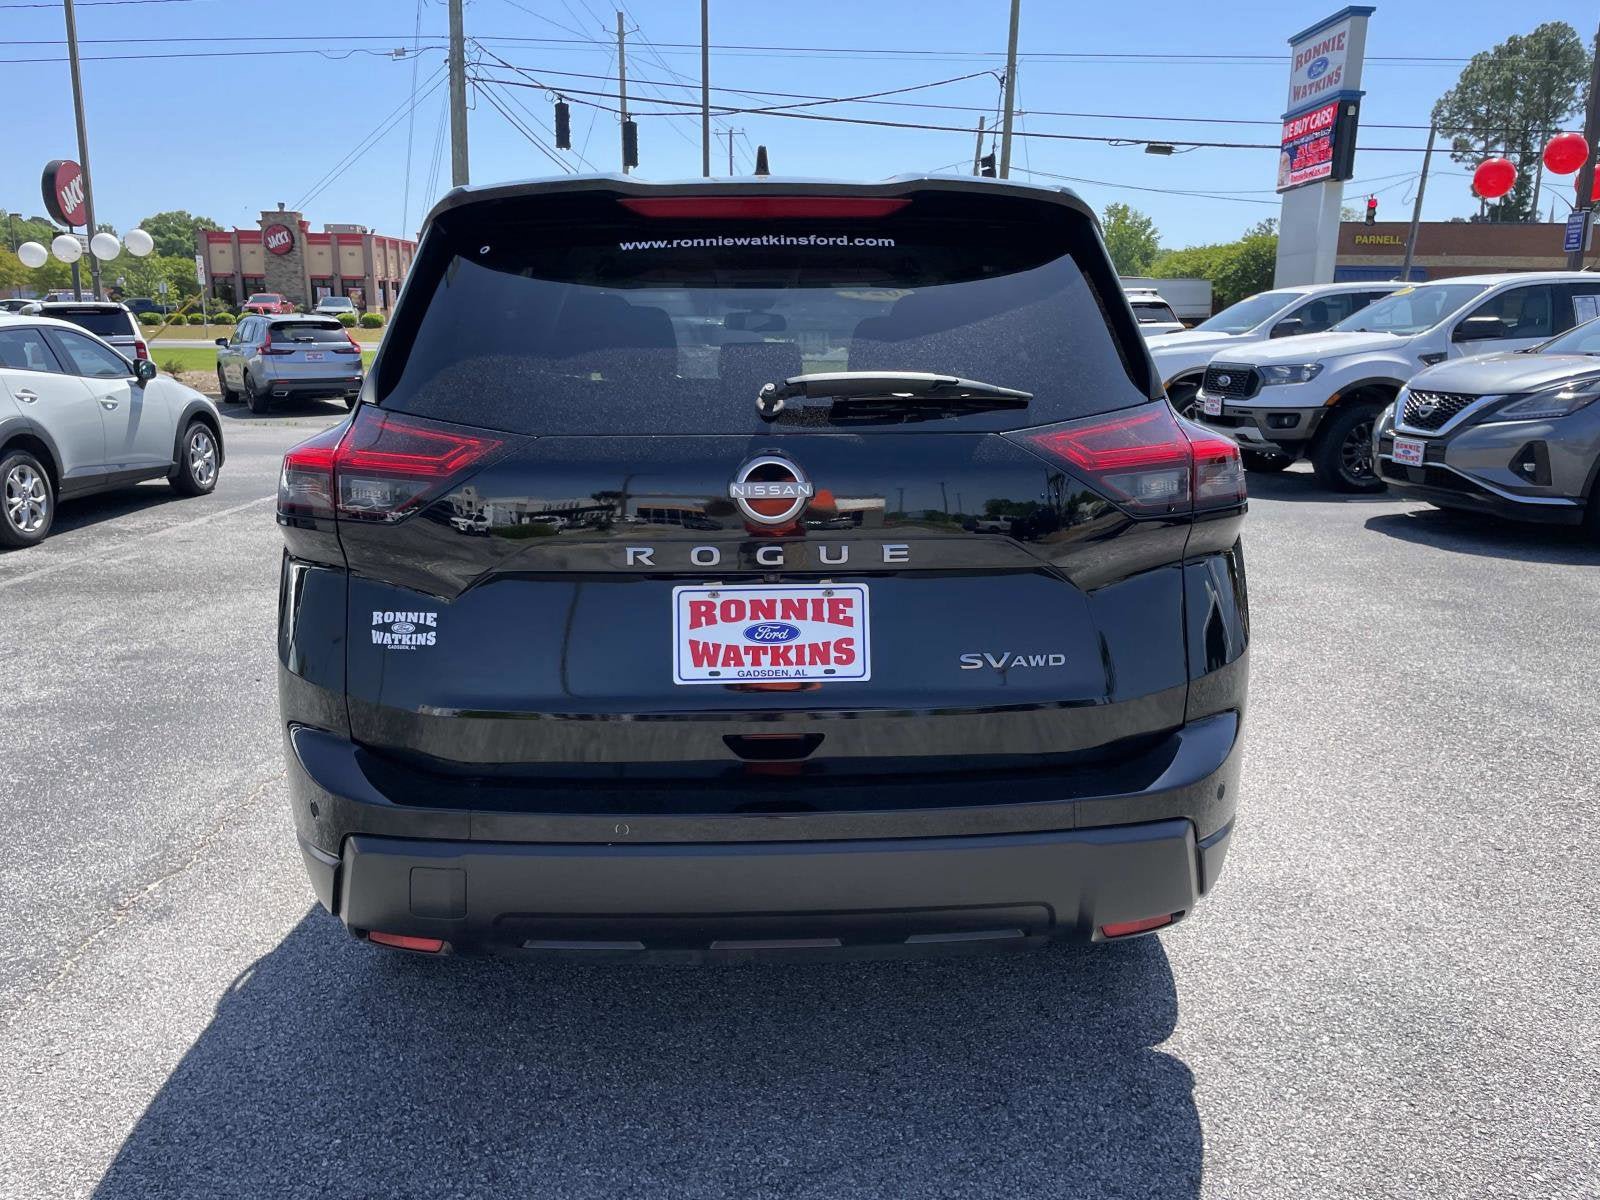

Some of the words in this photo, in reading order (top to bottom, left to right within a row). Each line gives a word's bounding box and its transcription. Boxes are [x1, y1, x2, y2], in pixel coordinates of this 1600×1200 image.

[1295, 31, 1346, 72] RONNIE
[1293, 65, 1342, 101] WATKINS
[1294, 116, 1311, 135] BUY
[619, 235, 896, 251] www.ronniewatkinsford.com
[1355, 235, 1402, 245] PARNELL
[731, 483, 812, 496] NISSAN
[626, 544, 910, 566] ROGUE
[372, 611, 437, 627] RONNIE
[689, 597, 854, 630] RONNIE
[371, 629, 436, 645] WATKINS
[754, 625, 790, 640] Ford
[688, 637, 856, 668] WATKINS
[960, 651, 1011, 669] SV
[1010, 654, 1066, 668] AWD
[737, 670, 791, 678] GADSDEN,
[794, 669, 808, 677] AL
